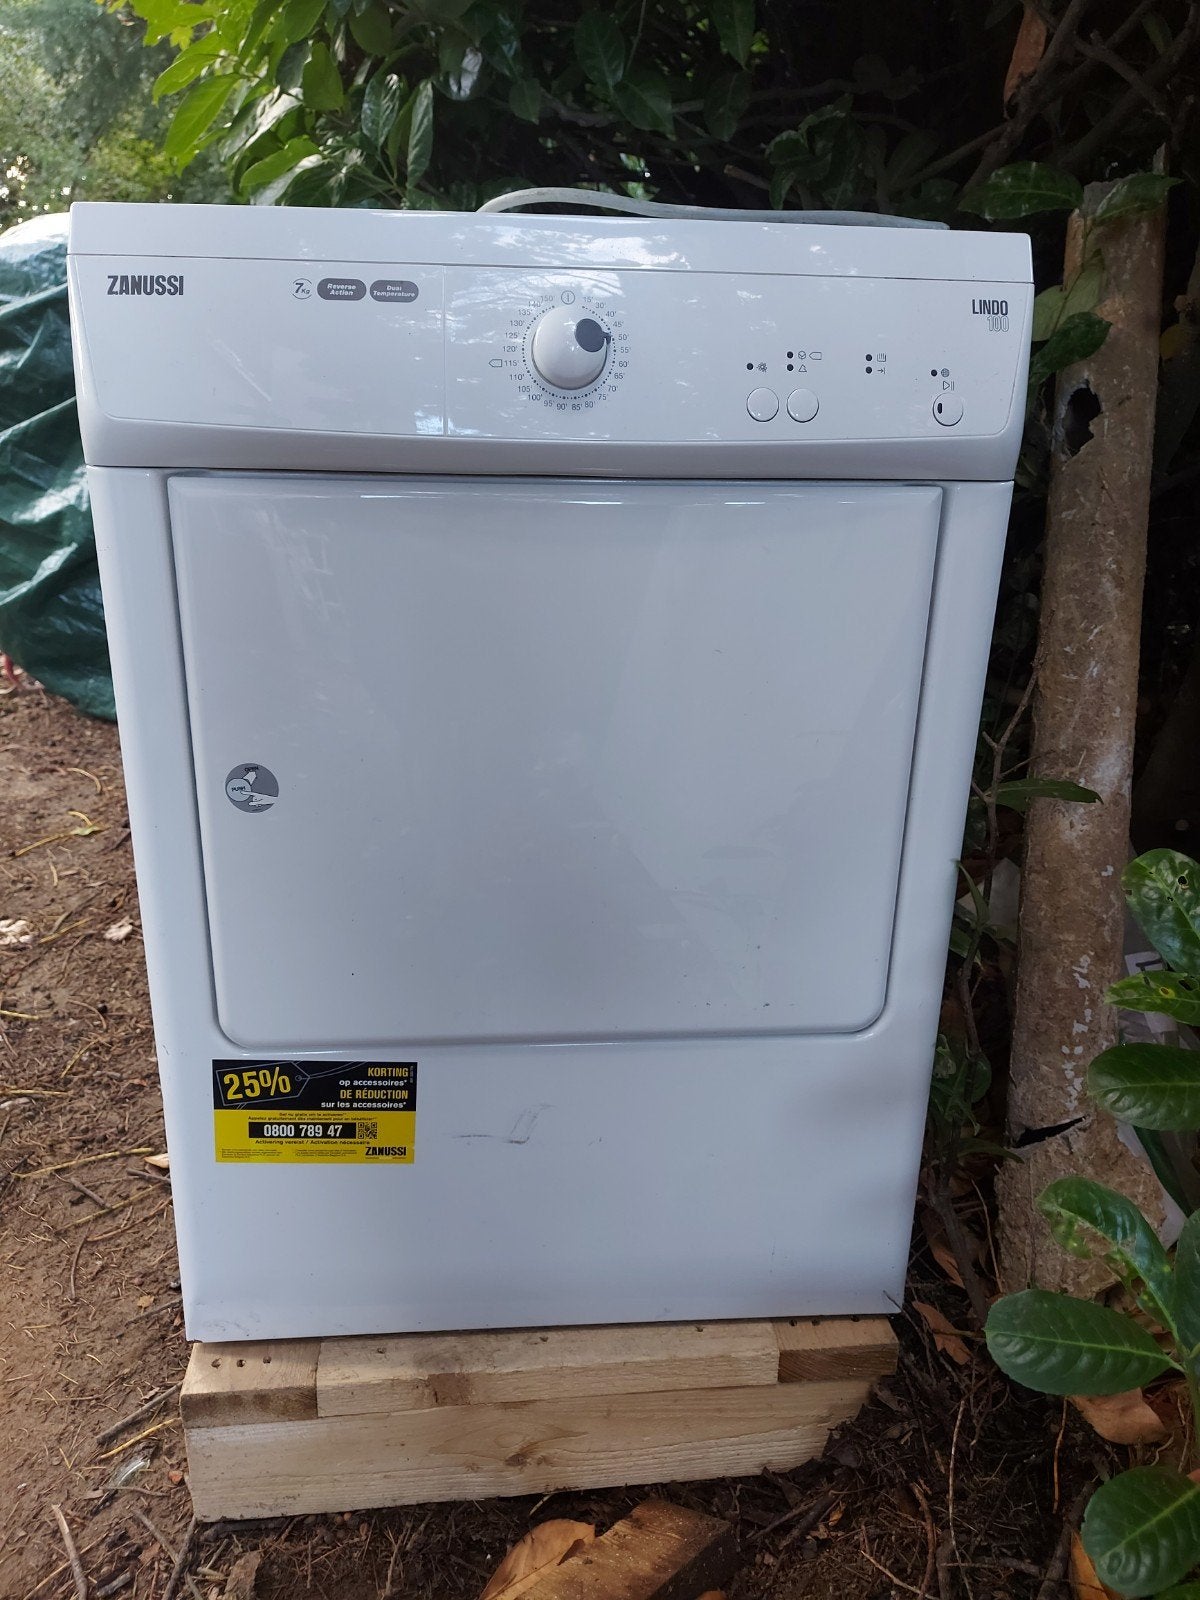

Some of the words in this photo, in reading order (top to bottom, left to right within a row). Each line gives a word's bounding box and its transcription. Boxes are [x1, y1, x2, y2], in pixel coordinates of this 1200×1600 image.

[107, 275, 184, 296] ZANUSSI
[972, 299, 1008, 316] LINDO
[987, 315, 1009, 332] 100
[367, 1067, 409, 1077] KORTING
[223, 1067, 291, 1100] 25%
[340, 1089, 353, 1099] DE
[355, 1087, 409, 1099] RÉDUCTION
[263, 1124, 295, 1137] 0800
[299, 1124, 323, 1137] 789
[327, 1124, 343, 1137] 47
[365, 1146, 407, 1156] ZANUSSI
